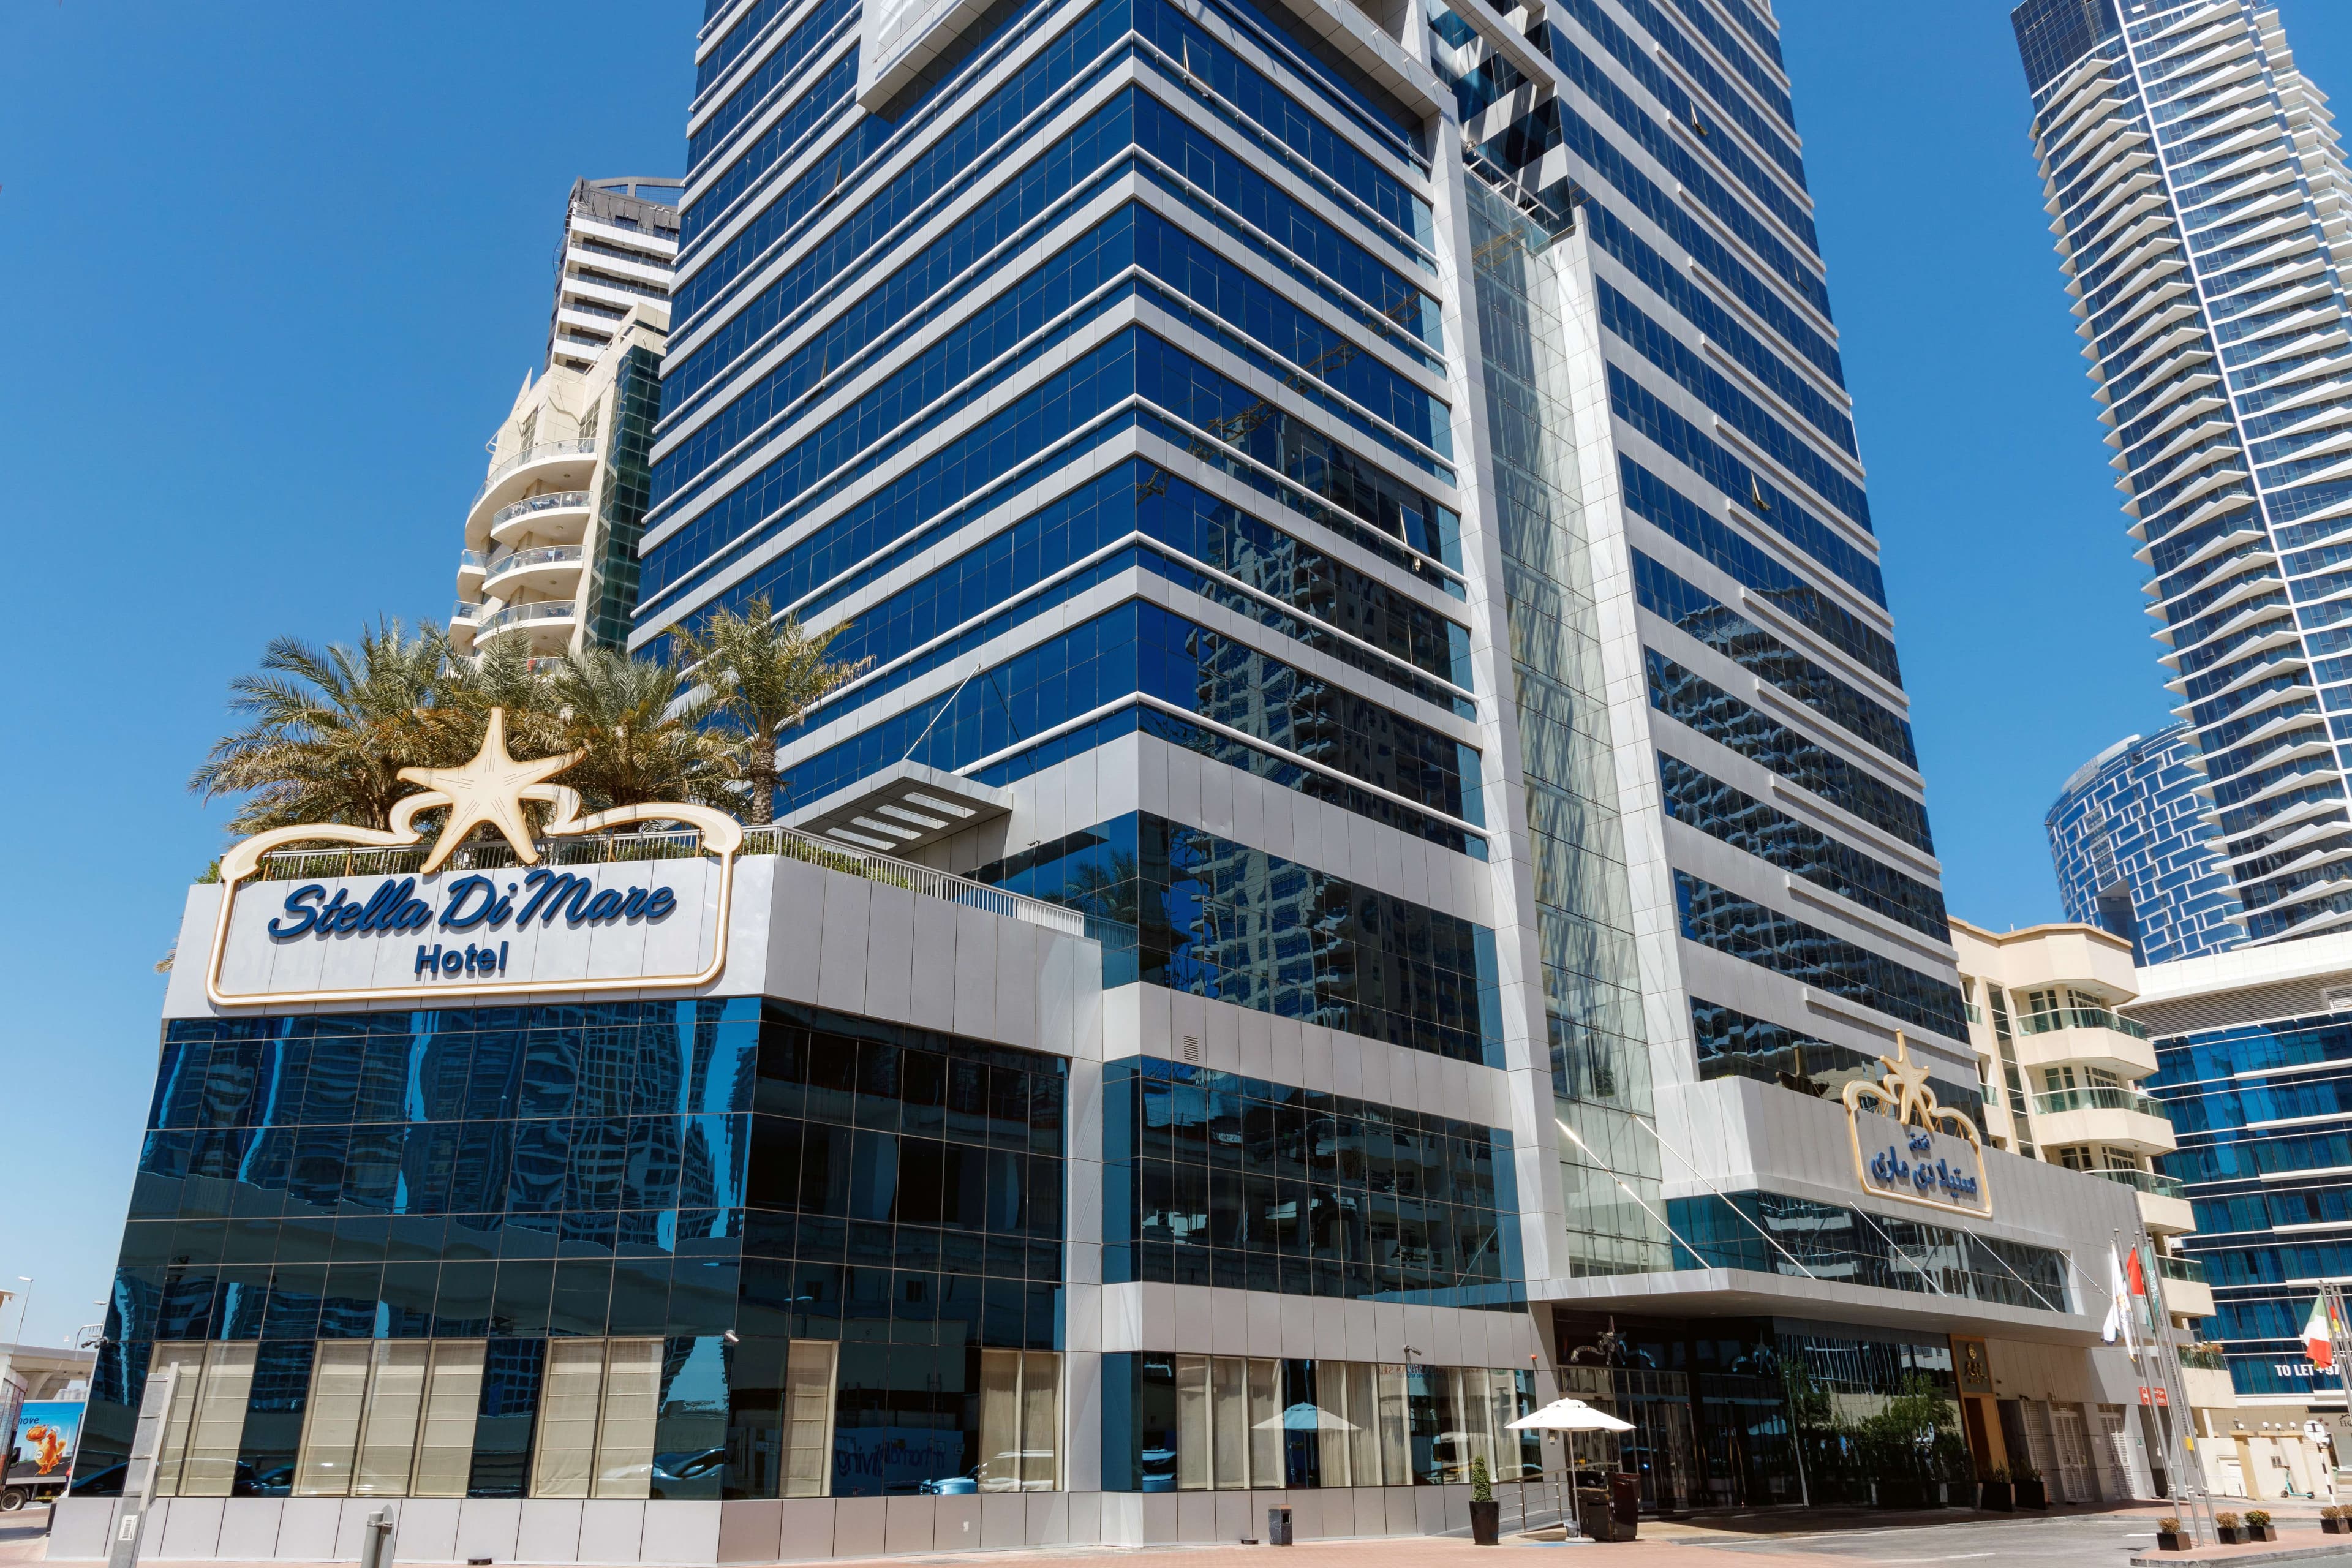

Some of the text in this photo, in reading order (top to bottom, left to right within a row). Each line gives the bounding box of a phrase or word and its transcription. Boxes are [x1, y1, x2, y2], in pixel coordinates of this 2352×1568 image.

[268, 869, 677, 937] Stella Di Mare
[414, 941, 509, 974] Hotel
[2274, 1365, 2291, 1377] TO
[2293, 1364, 2314, 1376] LET
